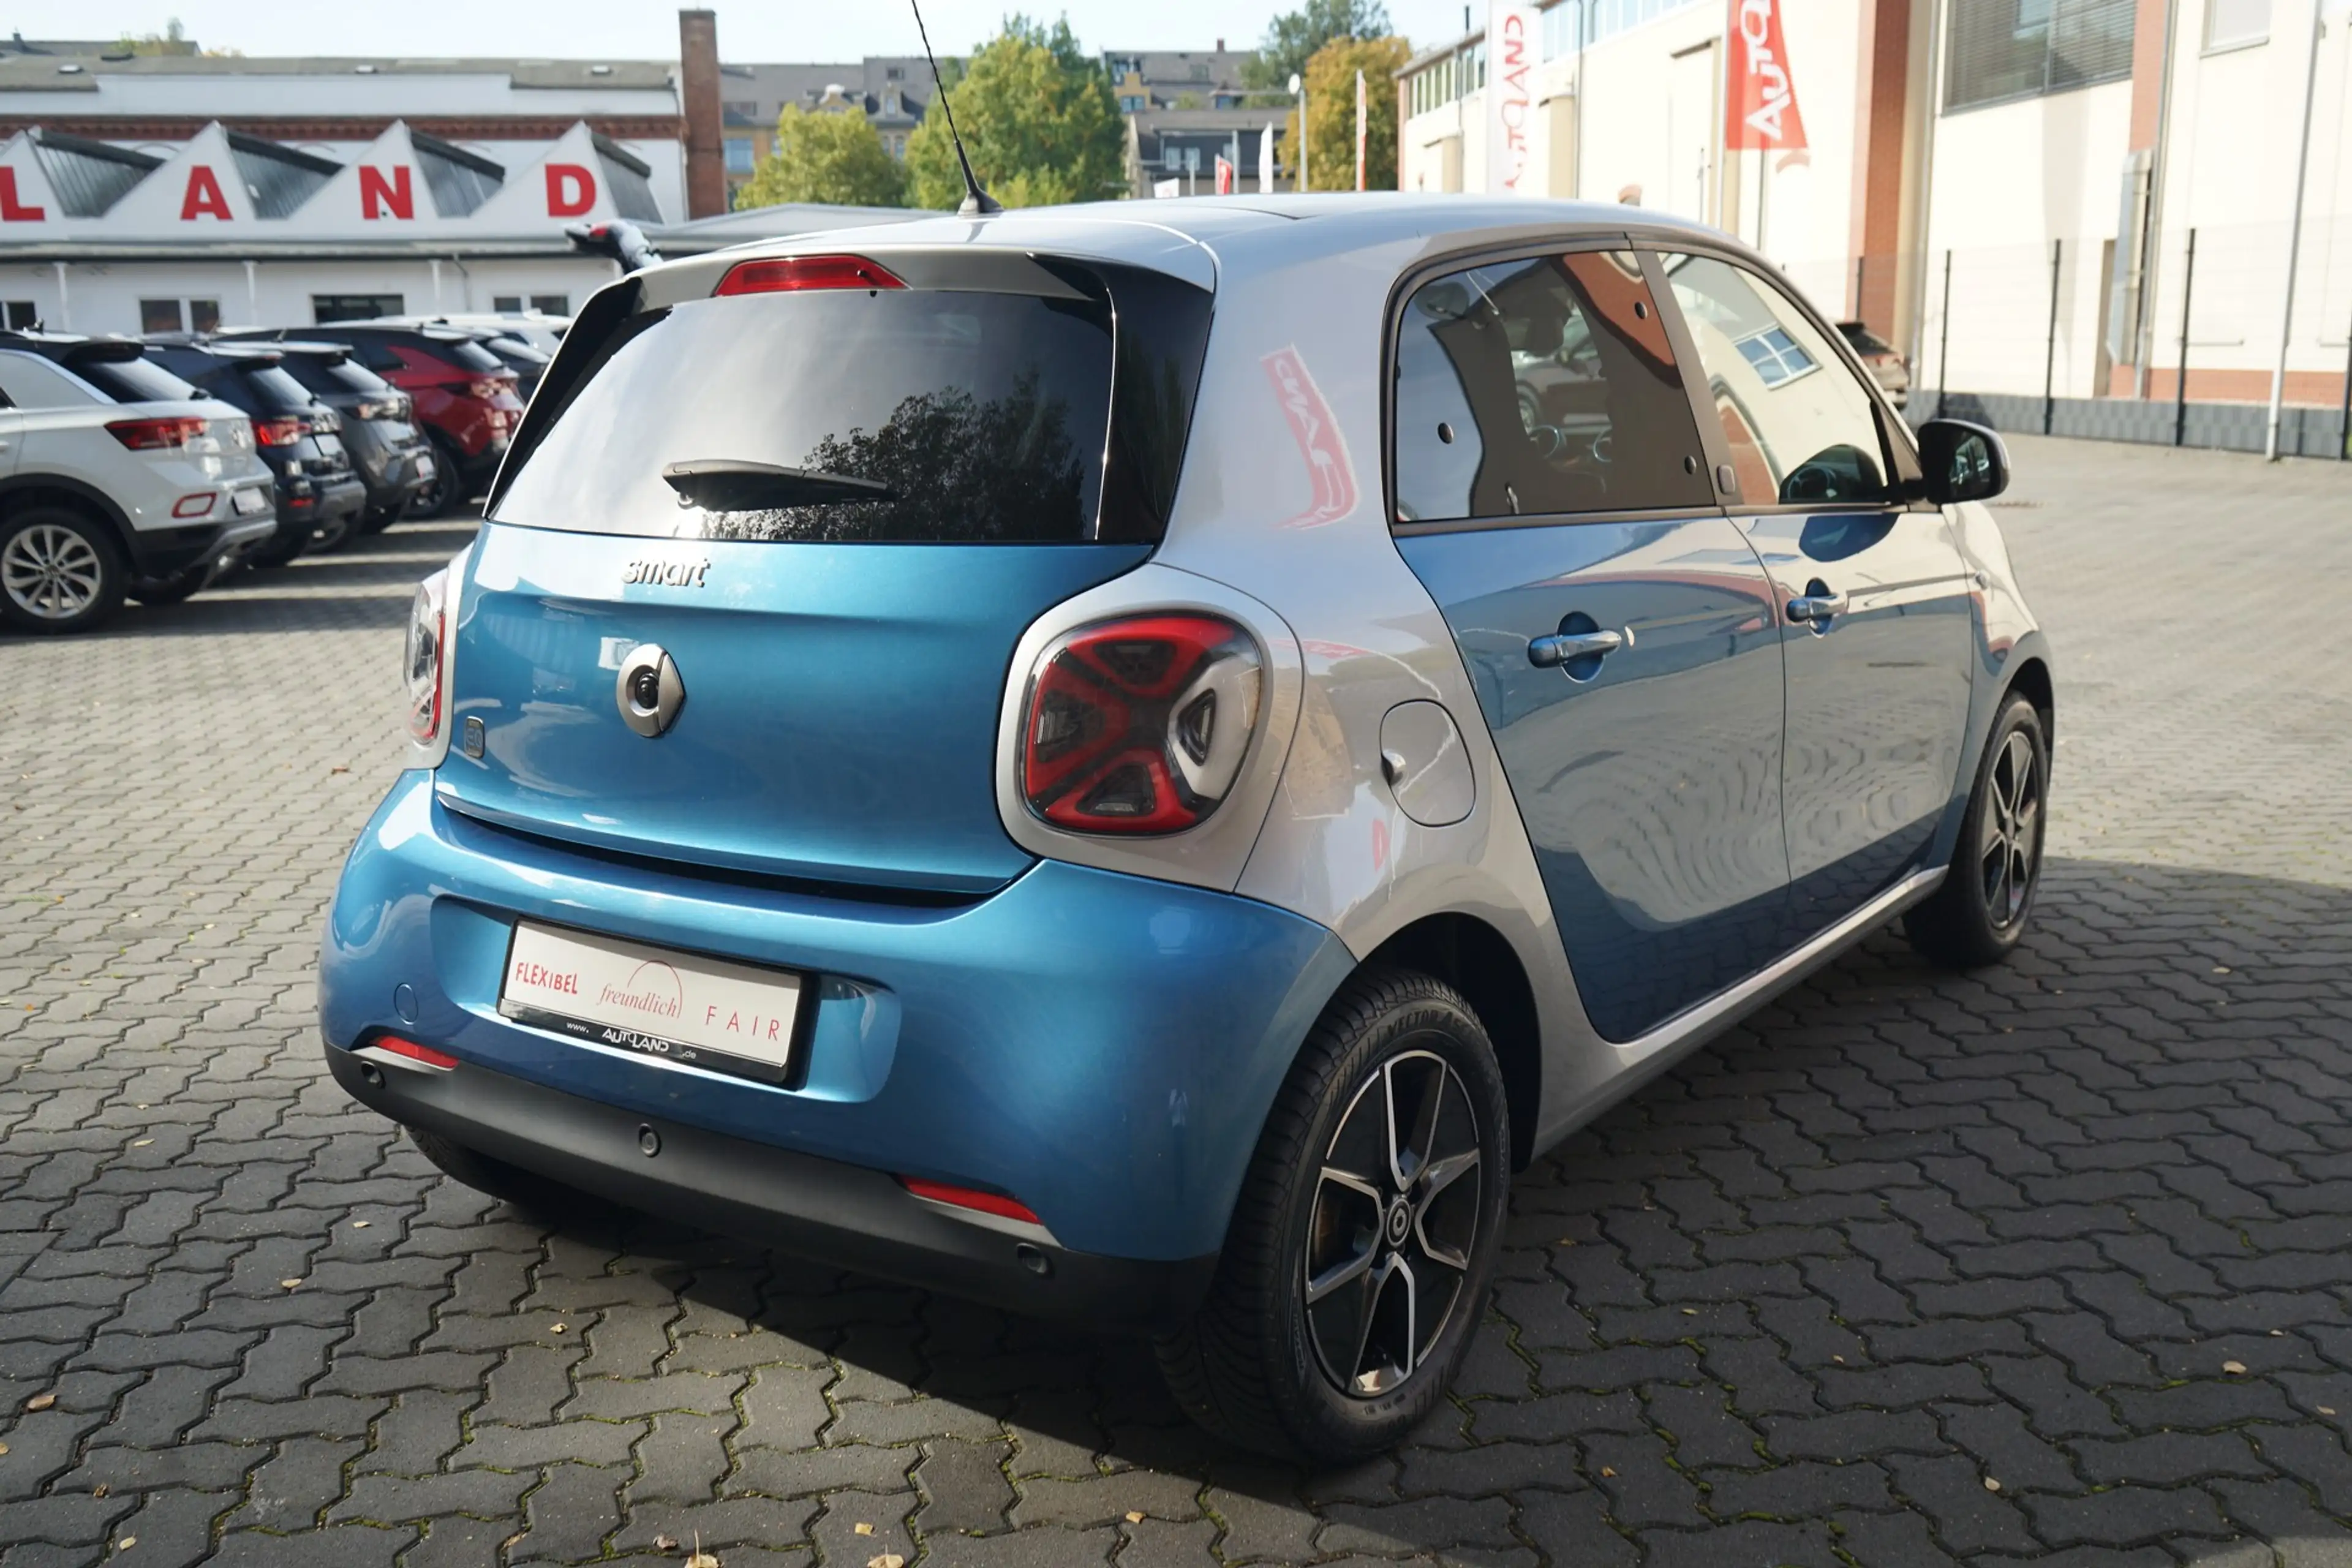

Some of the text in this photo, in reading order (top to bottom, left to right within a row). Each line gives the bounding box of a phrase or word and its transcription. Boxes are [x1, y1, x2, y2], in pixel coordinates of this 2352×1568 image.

[622, 556, 711, 588] smart
[516, 962, 780, 1041] FLEXIBEL freundlich FAIR
[566, 1022, 589, 1033] www.
[602, 1028, 669, 1052] AUTOLAND
